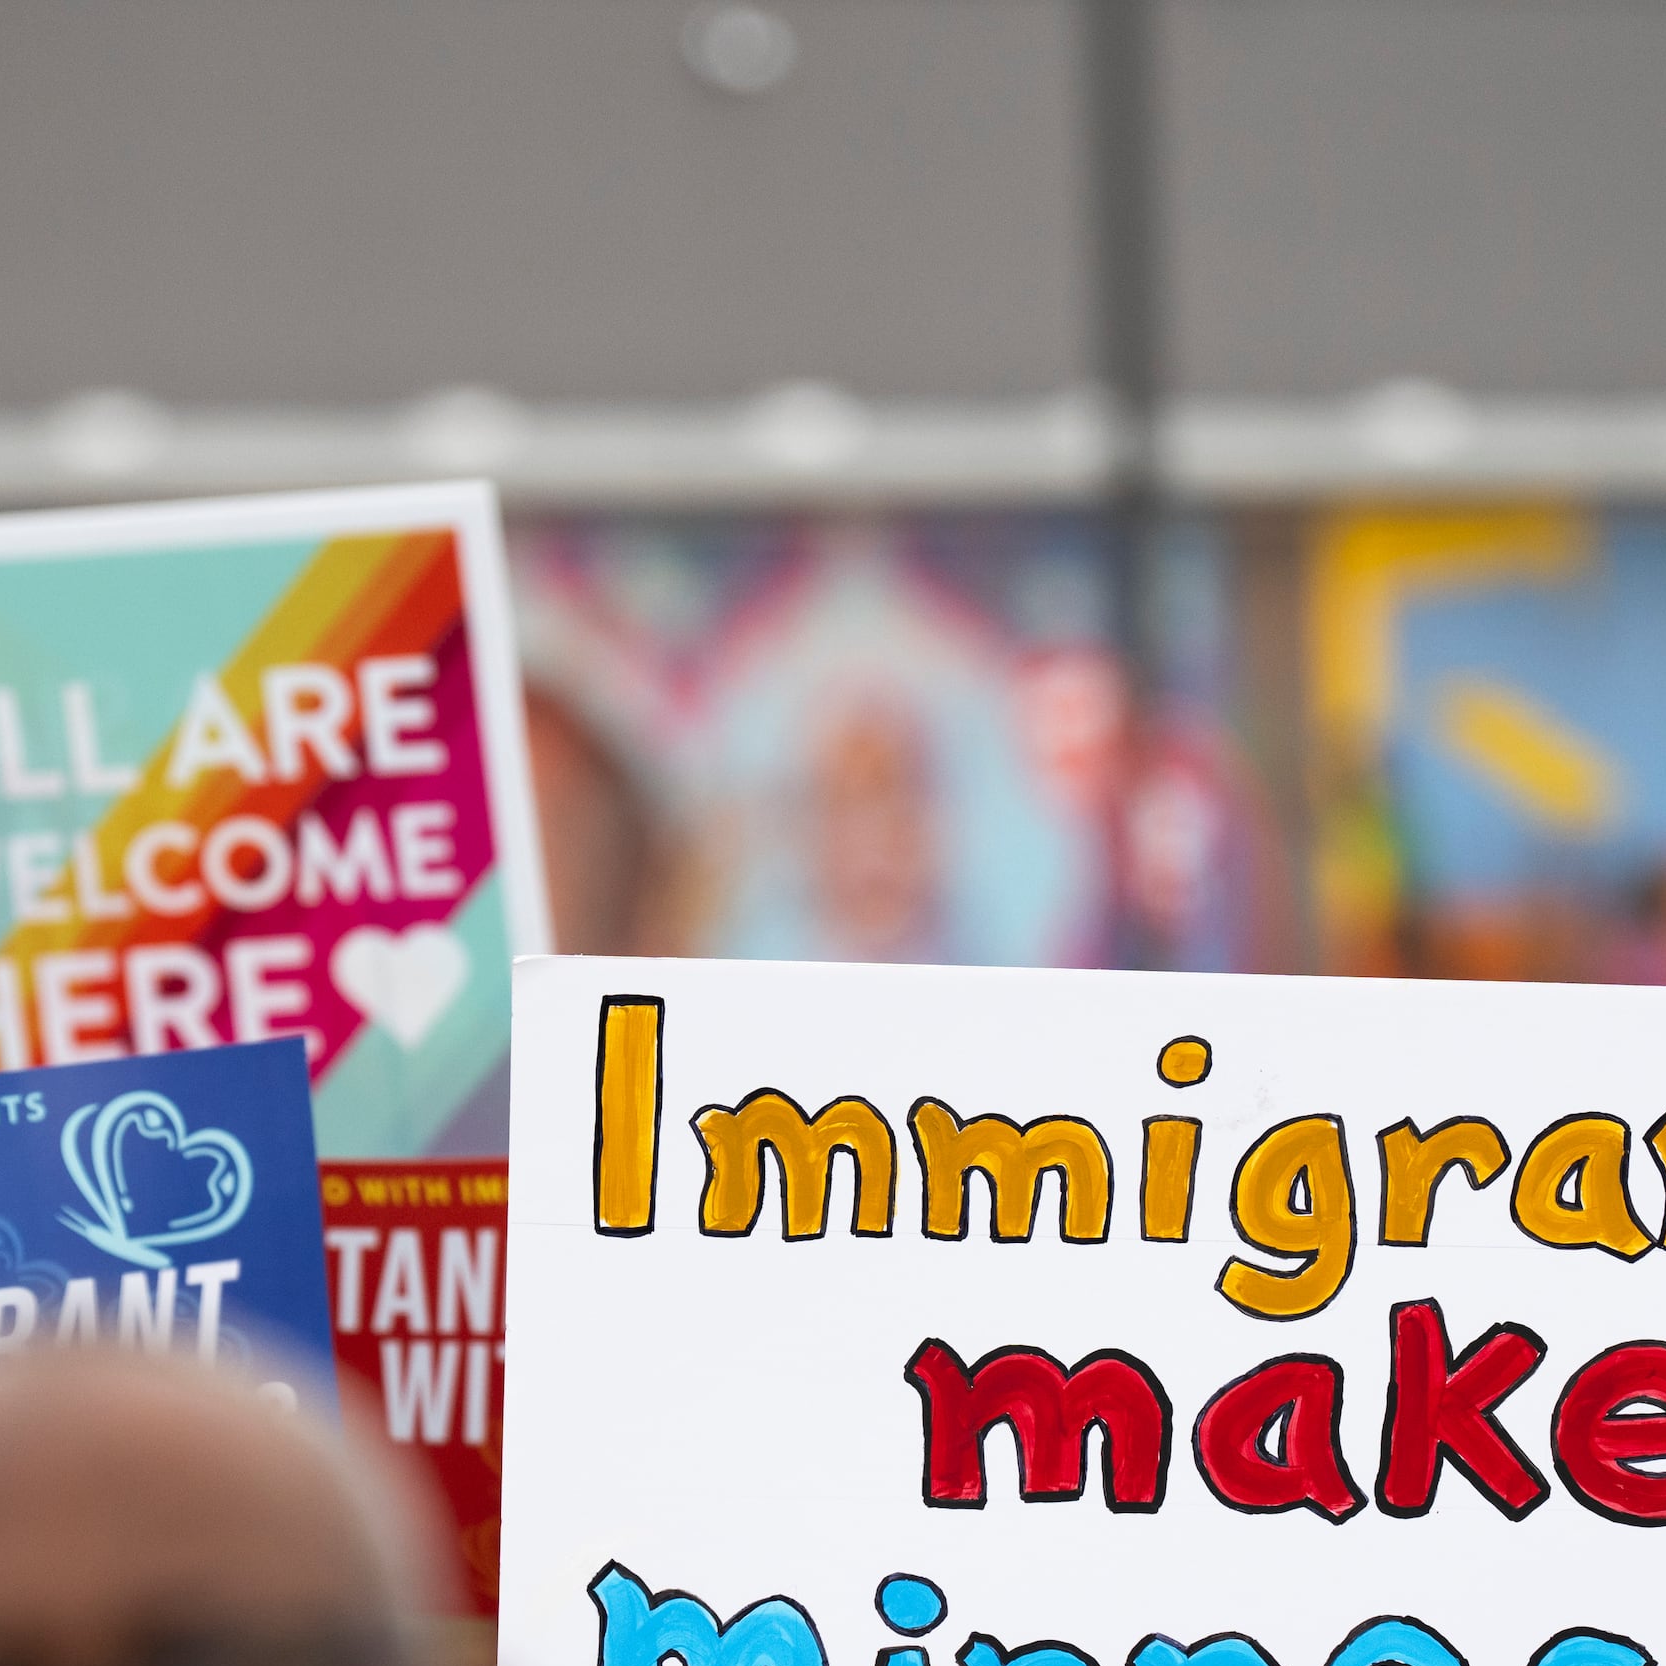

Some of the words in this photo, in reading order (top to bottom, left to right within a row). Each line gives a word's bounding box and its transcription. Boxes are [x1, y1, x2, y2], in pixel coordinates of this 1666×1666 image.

[165, 651, 450, 791] ARE
[356, 1177, 452, 1207] WITH
[324, 1226, 506, 1336] TAN
